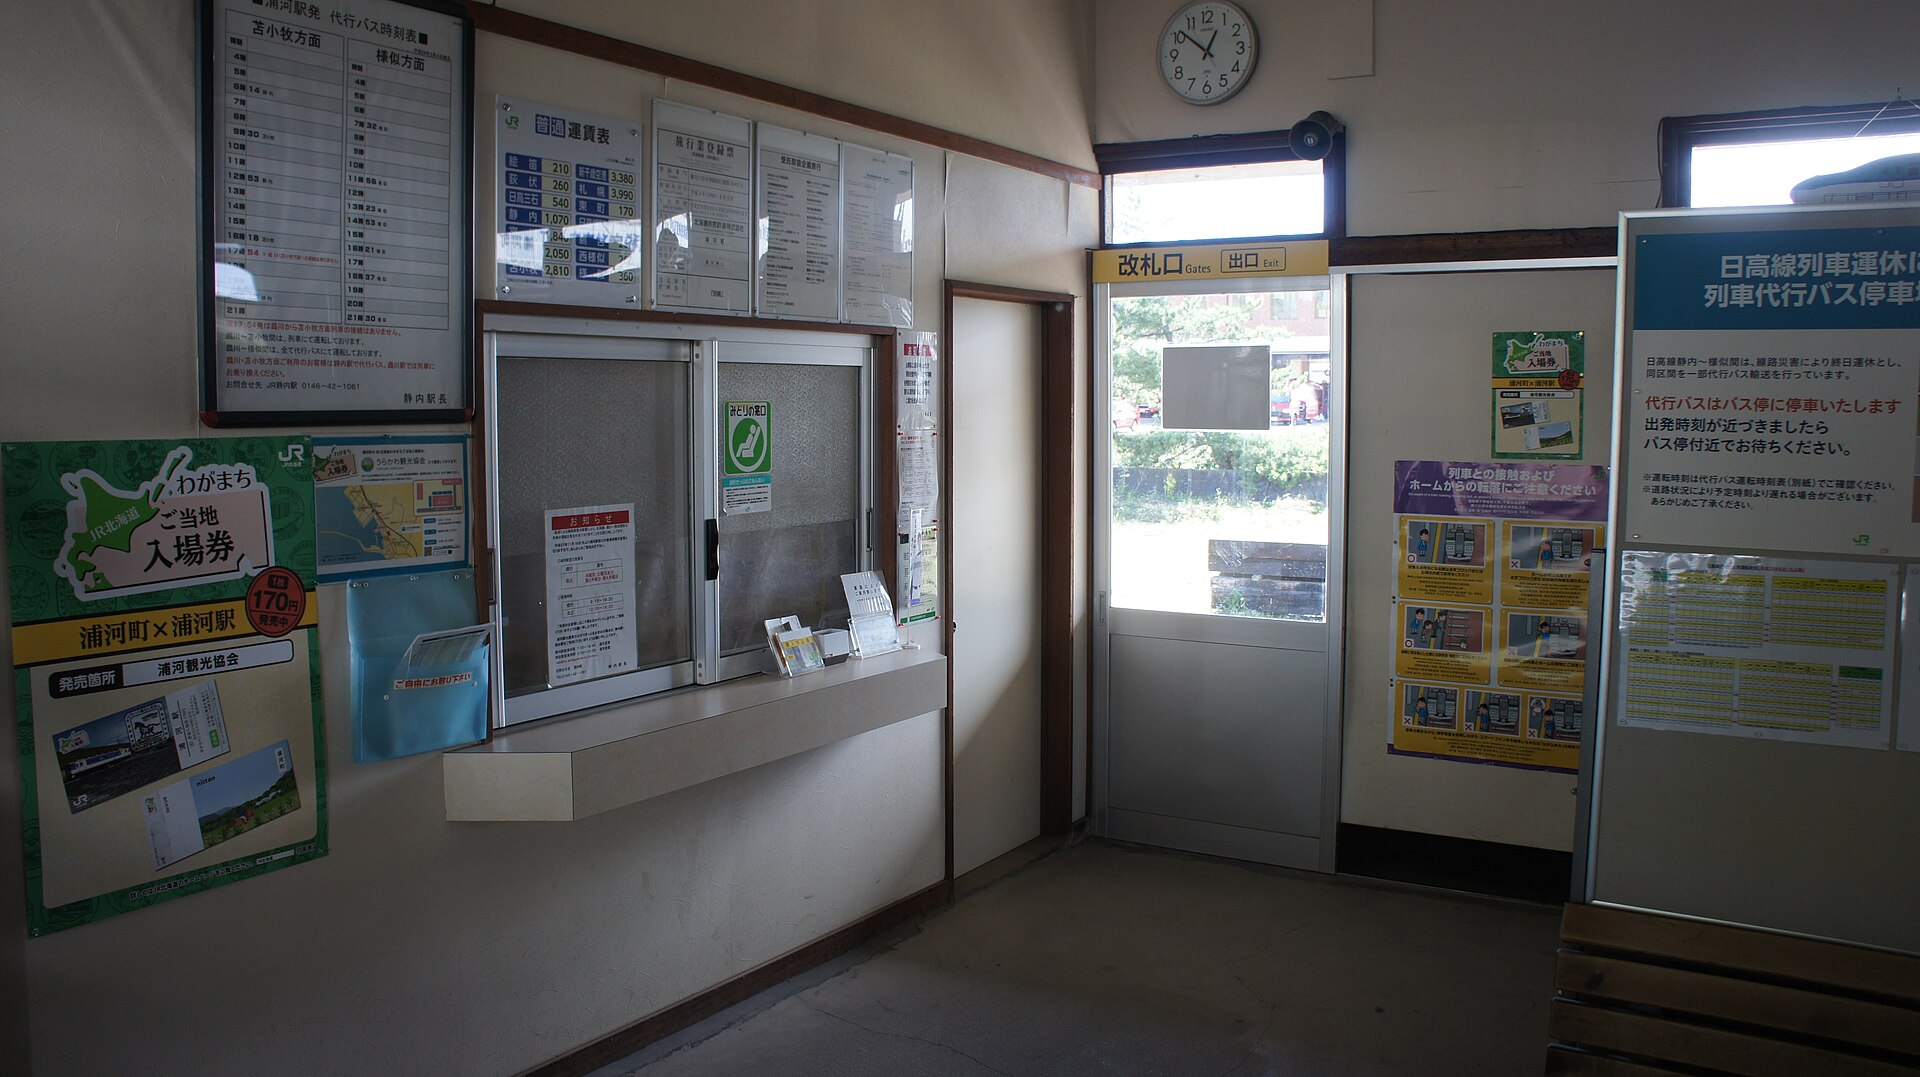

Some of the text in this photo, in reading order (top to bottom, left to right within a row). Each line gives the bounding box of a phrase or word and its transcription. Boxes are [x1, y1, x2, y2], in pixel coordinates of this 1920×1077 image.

[1187, 17, 1196, 30] 11
[1201, 10, 1214, 24] 12
[1222, 12, 1226, 26] 1
[252, 20, 321, 48] 苫小牧方面
[330, 10, 417, 44] 代行バス時刻表
[1232, 23, 1241, 37] 2
[1173, 31, 1185, 44] 10
[1170, 48, 1178, 62] 9
[1236, 41, 1245, 55] 3
[376, 48, 425, 72] 様似方面
[1231, 60, 1240, 73] 4
[1175, 66, 1183, 79] 8
[1188, 78, 1196, 91] 7
[1203, 80, 1211, 94] 6
[1219, 74, 1228, 87] 5
[249, 86, 260, 95] 14
[366, 122, 377, 130] 32
[537, 115, 610, 145] 普通運賃表
[247, 131, 259, 139] 30
[675, 135, 734, 158] 旅行業登録票
[509, 155, 569, 174] 絵笛 210
[247, 175, 259, 183] 53
[580, 166, 633, 185] 新千歳空港 3,380
[552, 180, 569, 191] 260
[580, 184, 633, 201] 札幌 3,990
[509, 190, 569, 208] 日高三石 540
[580, 200, 633, 217] 東町 170
[509, 209, 537, 223] 静内
[545, 214, 569, 226] 1,070
[247, 249, 259, 257] 54
[545, 248, 569, 260] 2,050
[580, 251, 605, 263] 西様似
[545, 265, 569, 277] 2,810
[1118, 253, 1279, 277] 改札口 Gates 出口 Exit
[619, 271, 633, 281] 360
[1704, 281, 1920, 308] 列車代行バス停車
[1527, 357, 1556, 368] 入場券
[1646, 356, 1902, 369] 日高線静内～様似間は、線路災害により終日運休とし、
[1646, 369, 1851, 381] 同区間を一部代行バス輸送を行っています。
[226, 380, 262, 390] お問合せ先
[267, 381, 298, 390] JR静内駅
[403, 393, 448, 404] 静内駅長
[1645, 396, 1901, 415] 代行バスはバス停に停車いたします
[730, 405, 766, 416] みどりの窓口
[1645, 417, 1829, 435] 出発時刻が近づきましたら
[279, 445, 304, 462] JR
[1644, 437, 1851, 456] バス停付近でお待ちください。
[376, 456, 425, 466] うらかわ観光協会
[327, 465, 349, 476] 入場券
[1449, 467, 1555, 482] 列車との接触および
[177, 470, 251, 495] わがまち
[1410, 480, 1596, 496] ホームからの転落にご注意ください
[1651, 497, 1753, 510] あらかじめご了承ください。
[90, 506, 140, 543] JR北海道
[160, 506, 220, 531] ご当地
[570, 515, 613, 526] お知らせ
[1852, 534, 1870, 544] JR
[144, 530, 235, 572] 入場券
[254, 590, 298, 612] 170円
[259, 614, 288, 628] 発売中
[79, 608, 236, 650] 浦河町×浦河駅
[59, 653, 239, 692] 発売箇所 浦河観光協会
[395, 673, 471, 689] ご自由にお取り下さい
[73, 794, 87, 806] JR
